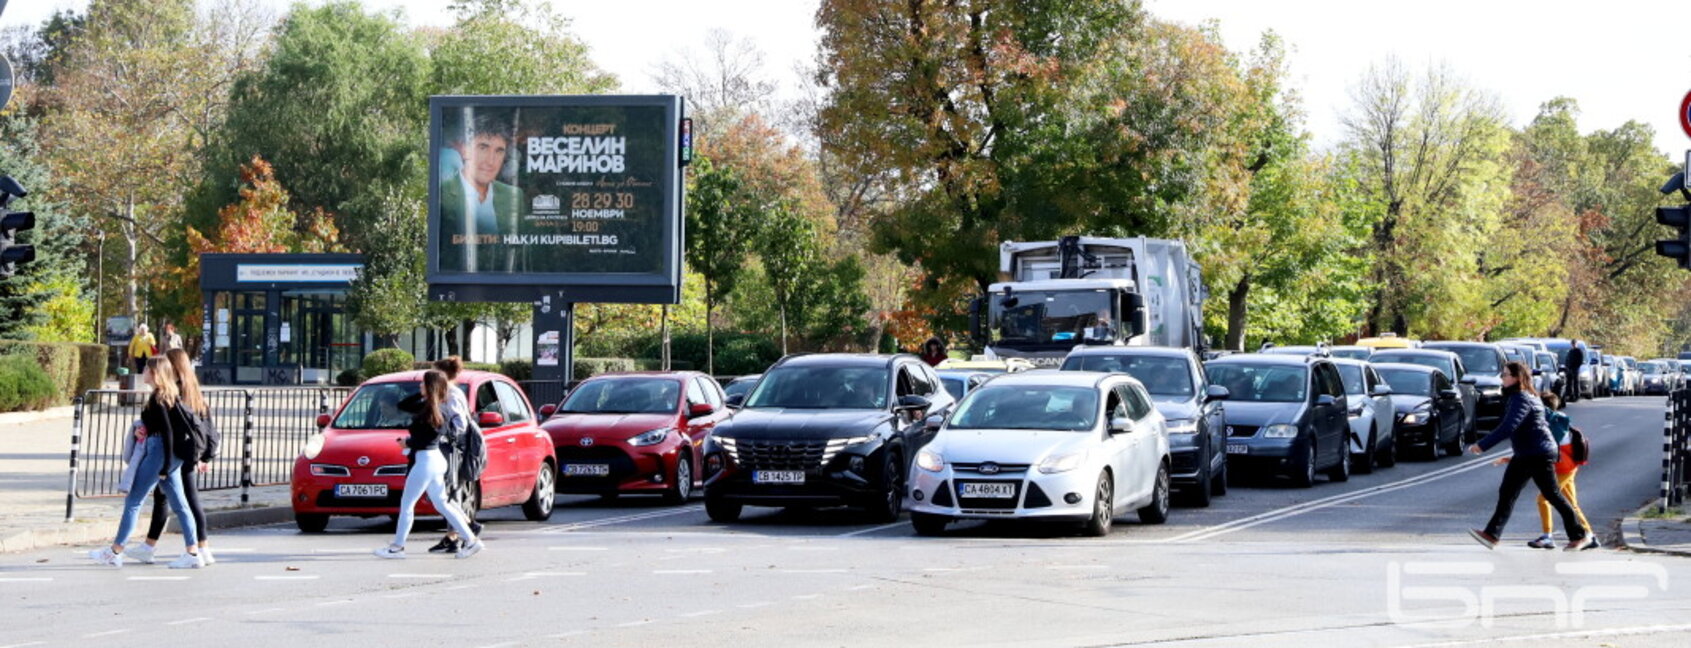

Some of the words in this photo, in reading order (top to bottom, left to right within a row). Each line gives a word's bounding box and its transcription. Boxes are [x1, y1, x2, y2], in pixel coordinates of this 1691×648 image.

[563, 124, 616, 135] КОНЦЕРТ
[527, 137, 626, 155] ВЕСЕЛИН
[527, 155, 625, 173] МАРИНОВ
[572, 193, 590, 209] 28
[593, 193, 612, 209] 29
[615, 193, 634, 209] 30
[571, 209, 625, 219] НОЕМВРИ
[540, 234, 619, 245] KUPIBILETI.BG
[1029, 357, 1065, 366] SCAN
[759, 471, 769, 481] CB
[340, 485, 351, 495] CA
[964, 484, 976, 494] CA
[978, 484, 1000, 494] 4804
[1002, 484, 1013, 494] XT
